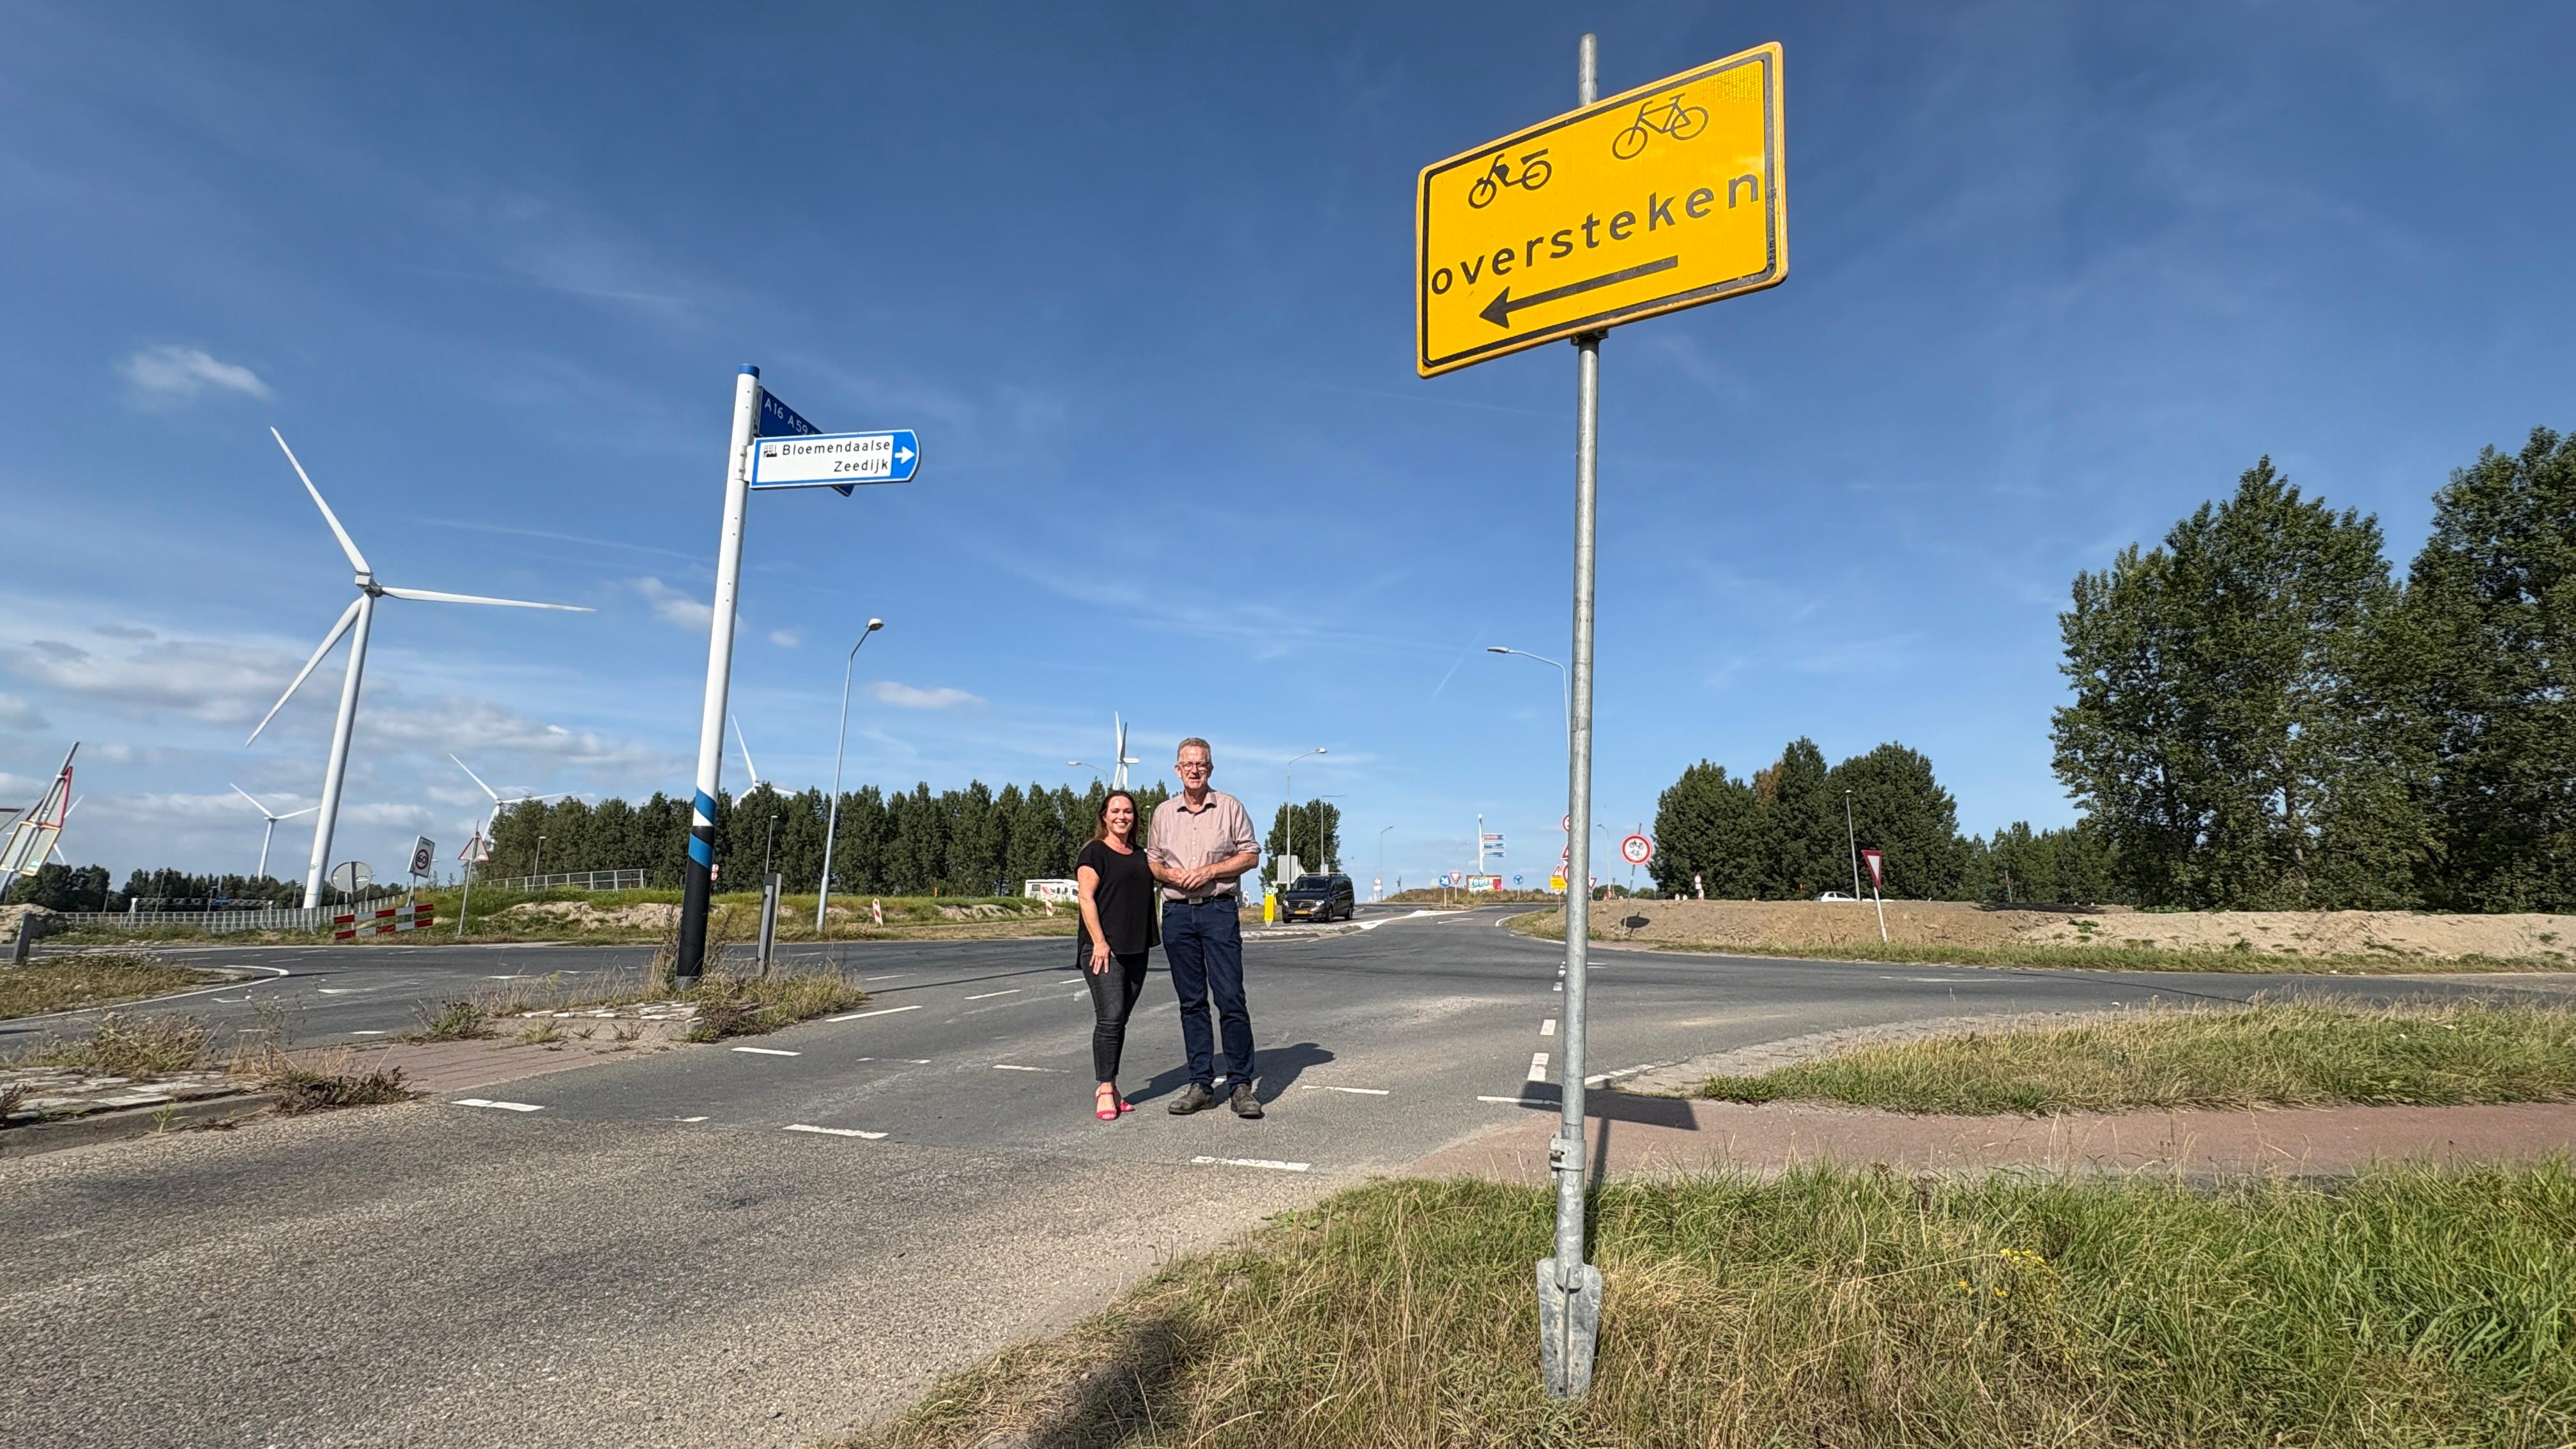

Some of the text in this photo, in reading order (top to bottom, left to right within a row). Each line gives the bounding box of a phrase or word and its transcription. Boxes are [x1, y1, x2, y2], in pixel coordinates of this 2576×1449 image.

[1431, 172, 1759, 295] oversteken
[764, 397, 808, 435] A16 A59
[782, 440, 891, 456] Bloemendaalse
[833, 459, 889, 474] Zeedijk
[417, 854, 427, 864] 60
